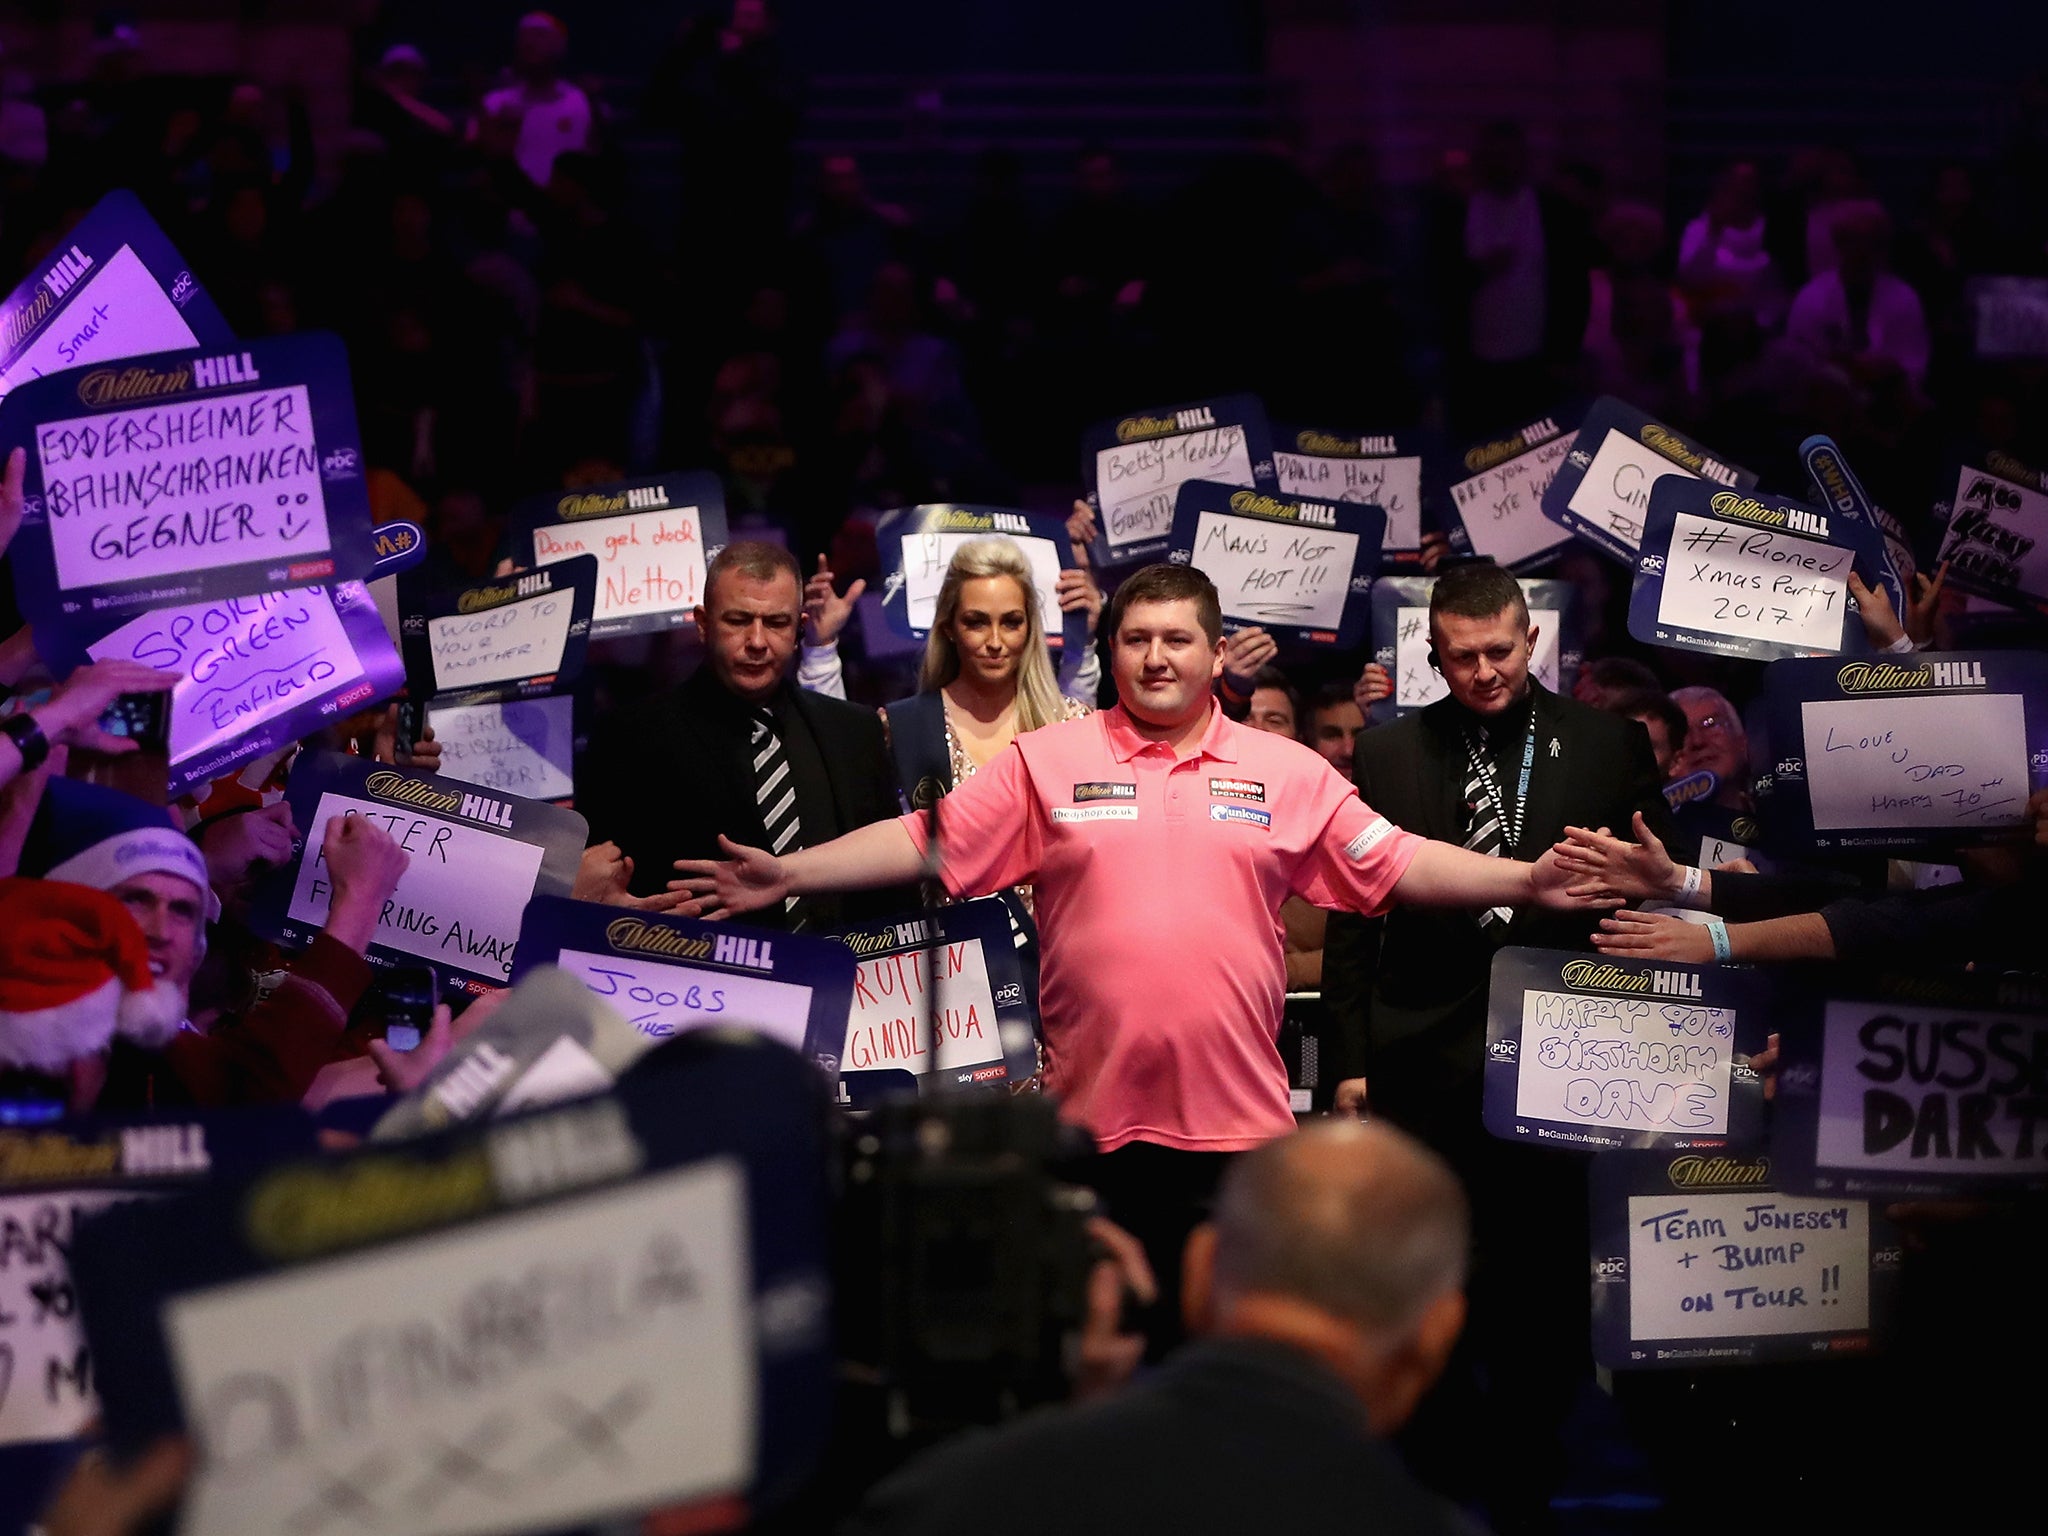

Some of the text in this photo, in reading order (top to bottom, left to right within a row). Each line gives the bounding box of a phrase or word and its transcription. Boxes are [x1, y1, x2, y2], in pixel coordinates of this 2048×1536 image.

[43, 244, 94, 299] HILL
[172, 274, 192, 300] PDC
[58, 303, 109, 363] Smart
[78, 352, 260, 408] William HILL
[42, 394, 299, 465] EDDERSHEIMER
[1176, 406, 1216, 429] HILL
[1521, 417, 1560, 446] HILL
[1360, 435, 1397, 454] HILL
[324, 452, 356, 471] PDC
[1700, 456, 1739, 488] HILL
[46, 444, 316, 518] BAHNSCHRANKEN
[627, 485, 669, 508] HILL
[1230, 491, 1336, 525] William HILL
[992, 512, 1030, 532] HILL
[1710, 492, 1829, 537] William HILL
[91, 502, 264, 561] GEGNER
[1641, 556, 1664, 569] PDC
[335, 583, 362, 603] PDC
[517, 571, 552, 596] HILL
[1772, 575, 1837, 611] Party
[192, 607, 310, 683] GREEN
[1837, 661, 1986, 694] William HILL
[210, 660, 336, 729] ENFIELD
[320, 683, 373, 715] sky sports
[1777, 762, 1802, 773] PDC
[1904, 764, 1966, 782] DAD
[366, 771, 512, 829] William HILL
[1112, 785, 1135, 796] HILL
[1211, 780, 1263, 795] BURGHLEY
[1228, 808, 1270, 825] unicorn
[282, 927, 298, 939] 18+
[606, 917, 774, 970] William HILL
[449, 976, 496, 994] sky spor
[586, 966, 726, 1012] JOOBS
[1562, 960, 1702, 996] William HILL
[996, 987, 1020, 1000] PDC
[1536, 994, 1650, 1034] HAPPY
[1492, 1043, 1516, 1055] PDC
[957, 1067, 1005, 1084] sky sports
[1736, 1067, 1759, 1078] PDC
[1564, 1078, 1717, 1128] DAVE
[1515, 1125, 1530, 1135] 18+
[1863, 1089, 2048, 1161] DART
[1668, 1155, 1771, 1189] William
[1641, 1204, 1848, 1243] TEAM JONESEY
[1599, 1261, 1625, 1274] PDC
[1712, 1242, 1806, 1271] BUMP
[1875, 1251, 1900, 1263] PDC
[1723, 1286, 1808, 1310] TOUR
